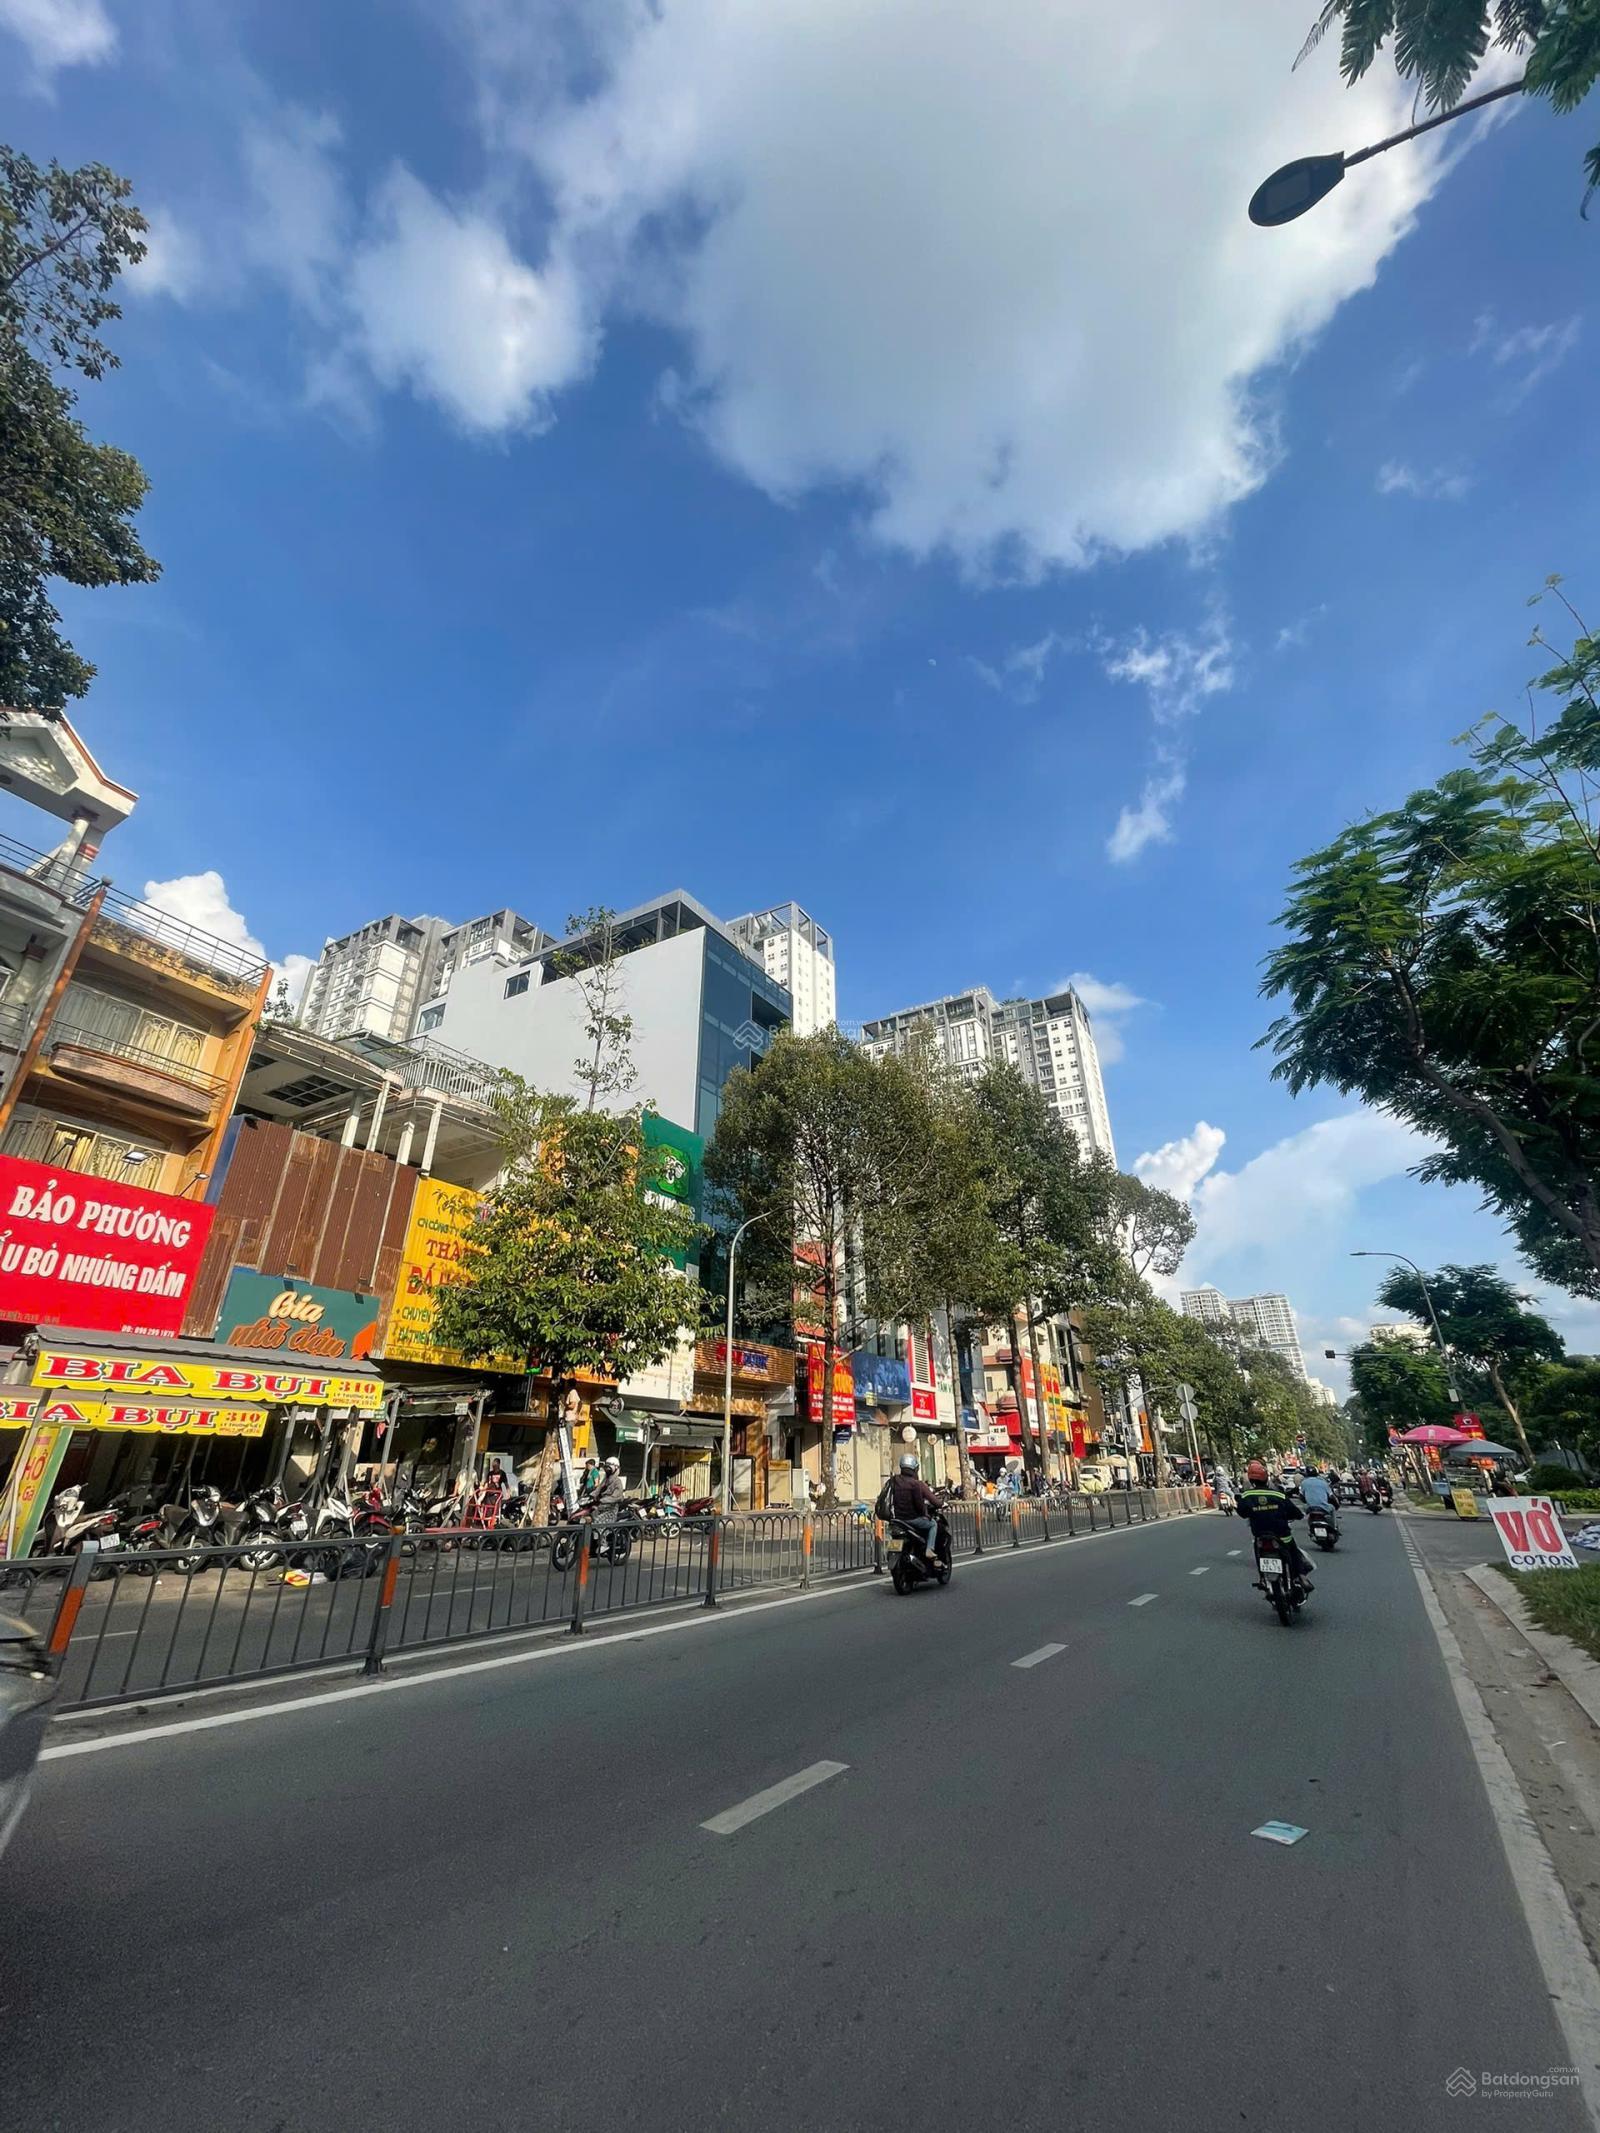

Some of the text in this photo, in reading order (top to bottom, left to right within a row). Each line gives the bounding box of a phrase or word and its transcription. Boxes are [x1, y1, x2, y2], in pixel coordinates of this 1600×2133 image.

[8, 1179, 192, 1249] BẢO PHƯƠNG
[21, 1242, 60, 1278] BÒ
[58, 1254, 139, 1292] NHÚNG
[136, 1261, 187, 1298] DẤM
[268, 1290, 326, 1323] Bia
[227, 1317, 292, 1349] nhà
[40, 1355, 376, 1399] BIA BỤI 310
[0, 1400, 261, 1431] IA BỤI 310
[1494, 1498, 1564, 1553] VỚ
[1511, 1554, 1575, 1567] COTON
